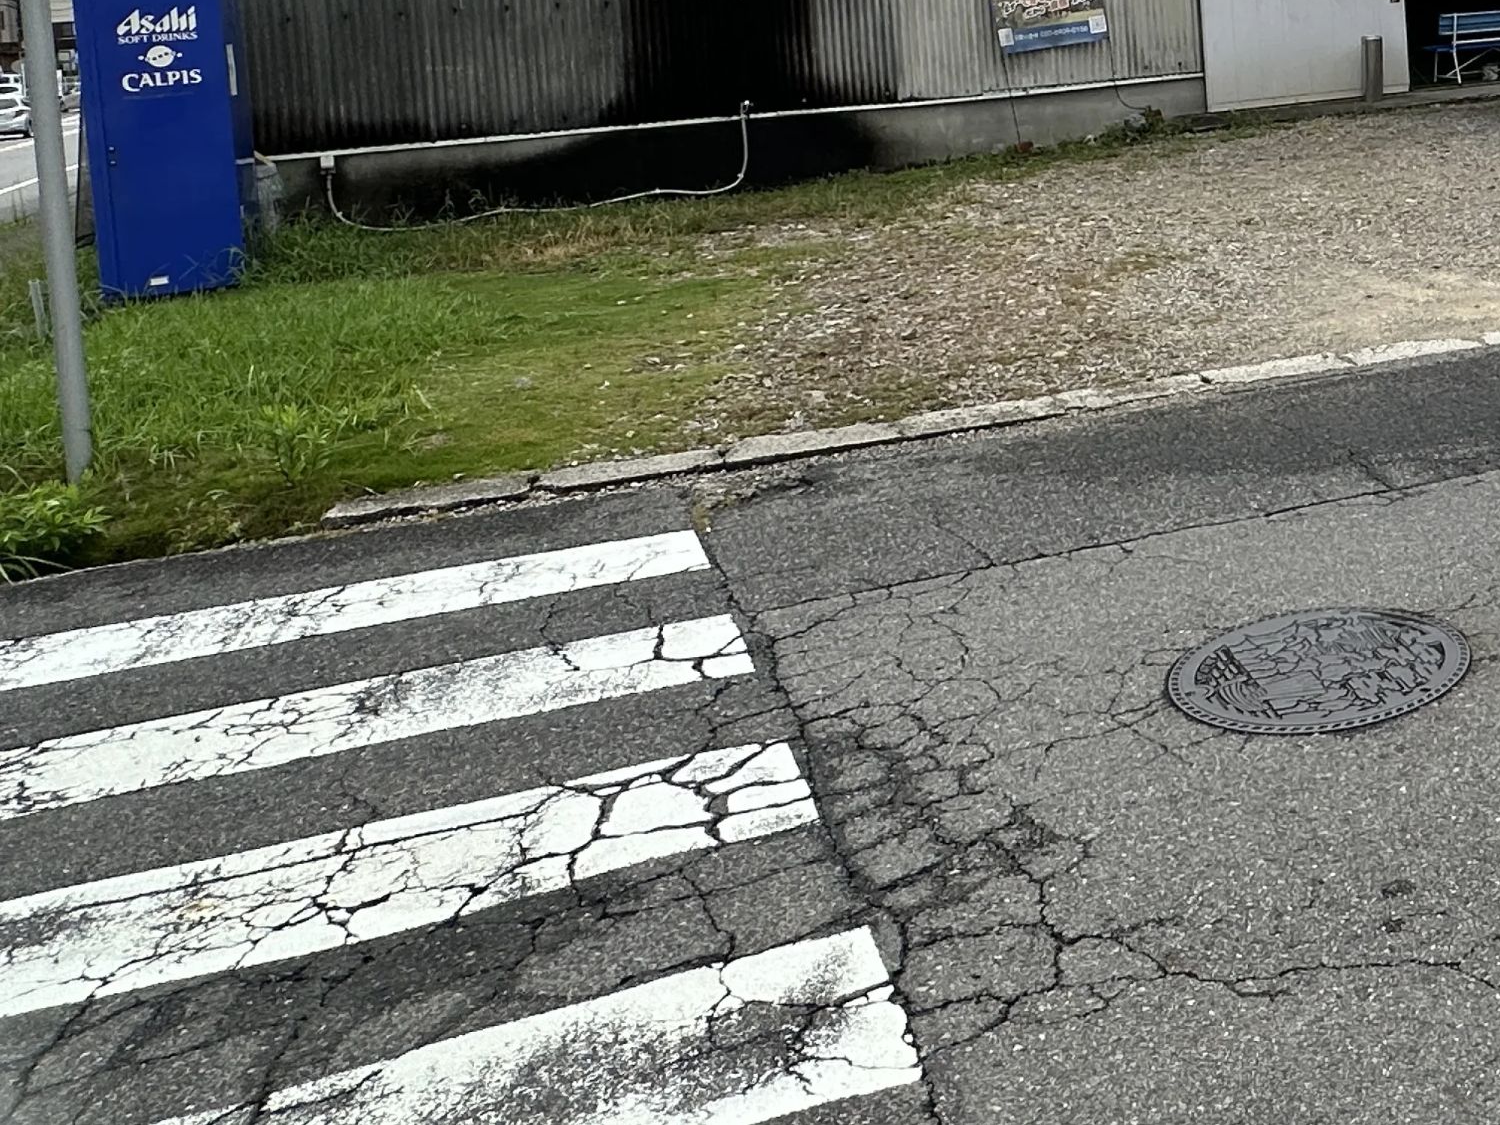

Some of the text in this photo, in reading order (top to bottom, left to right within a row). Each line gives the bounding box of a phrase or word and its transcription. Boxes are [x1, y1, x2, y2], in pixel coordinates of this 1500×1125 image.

[116, 5, 197, 35] Asahi
[117, 31, 198, 45] SOFT DRINKS
[121, 69, 203, 92] CALPIS
